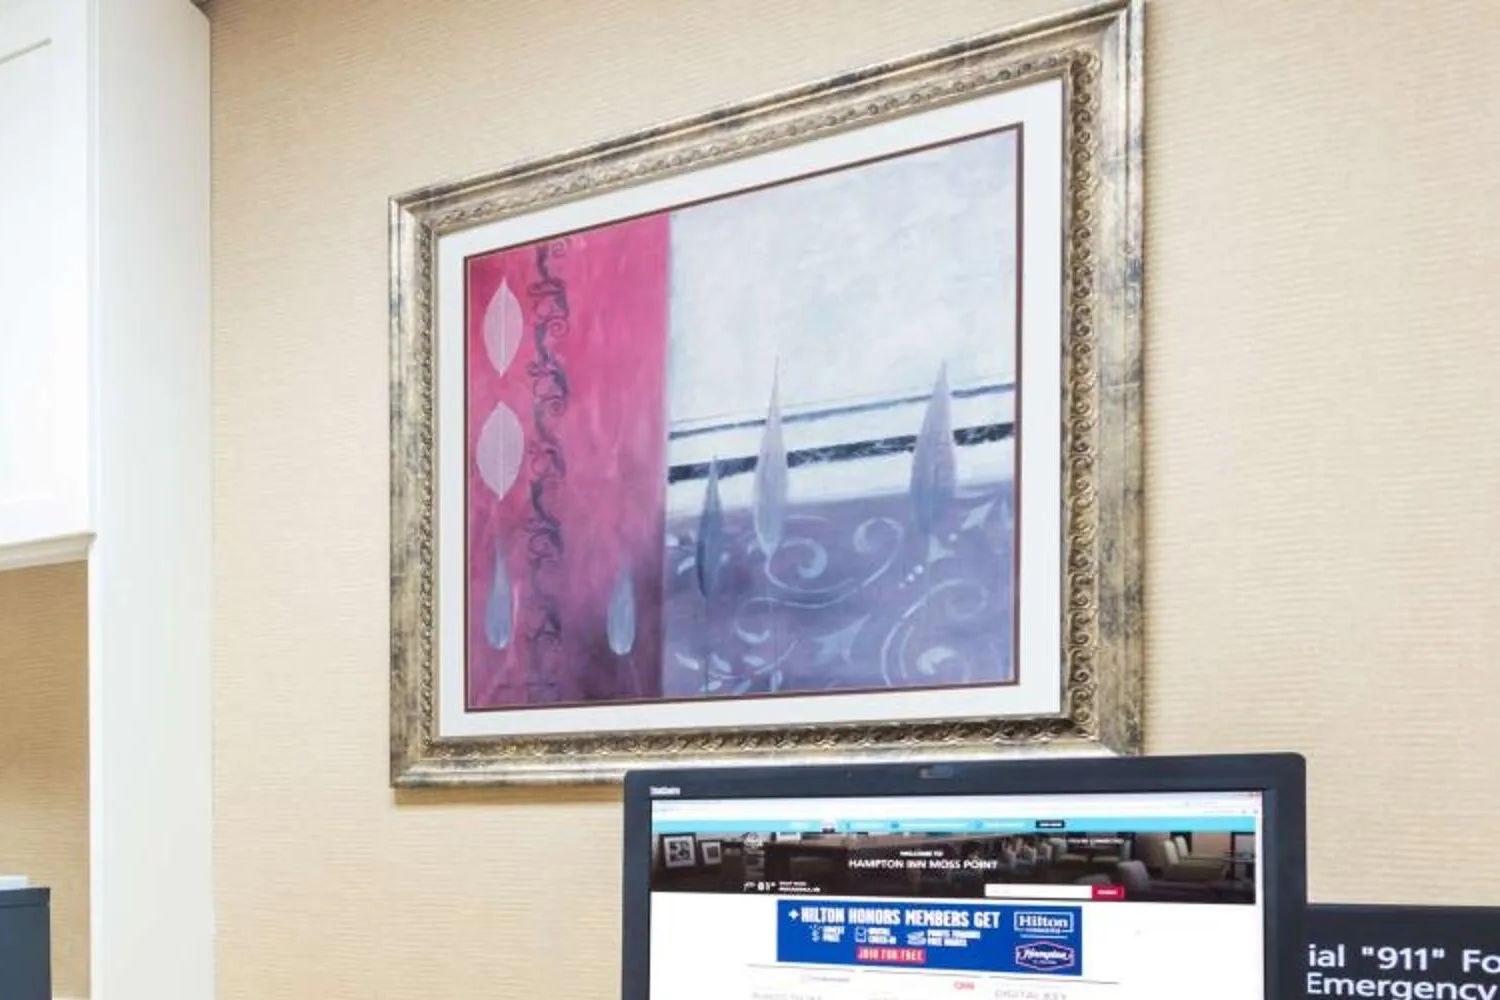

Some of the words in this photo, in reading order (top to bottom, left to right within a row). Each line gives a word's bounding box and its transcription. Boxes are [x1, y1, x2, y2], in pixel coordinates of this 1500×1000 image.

[848, 859, 904, 869] HAMPTON
[905, 859, 927, 869] INN
[929, 859, 961, 869] MOSS
[963, 859, 998, 869] POINT
[801, 907, 845, 923] HILTON
[848, 908, 901, 924] HONORS
[905, 909, 969, 927] MEMBERS
[974, 911, 1000, 928] GET
[1019, 915, 1068, 927] Hilton
[1308, 944, 1345, 968] ial
[1361, 946, 1445, 971] "911"
[1462, 949, 1500, 973] Fo
